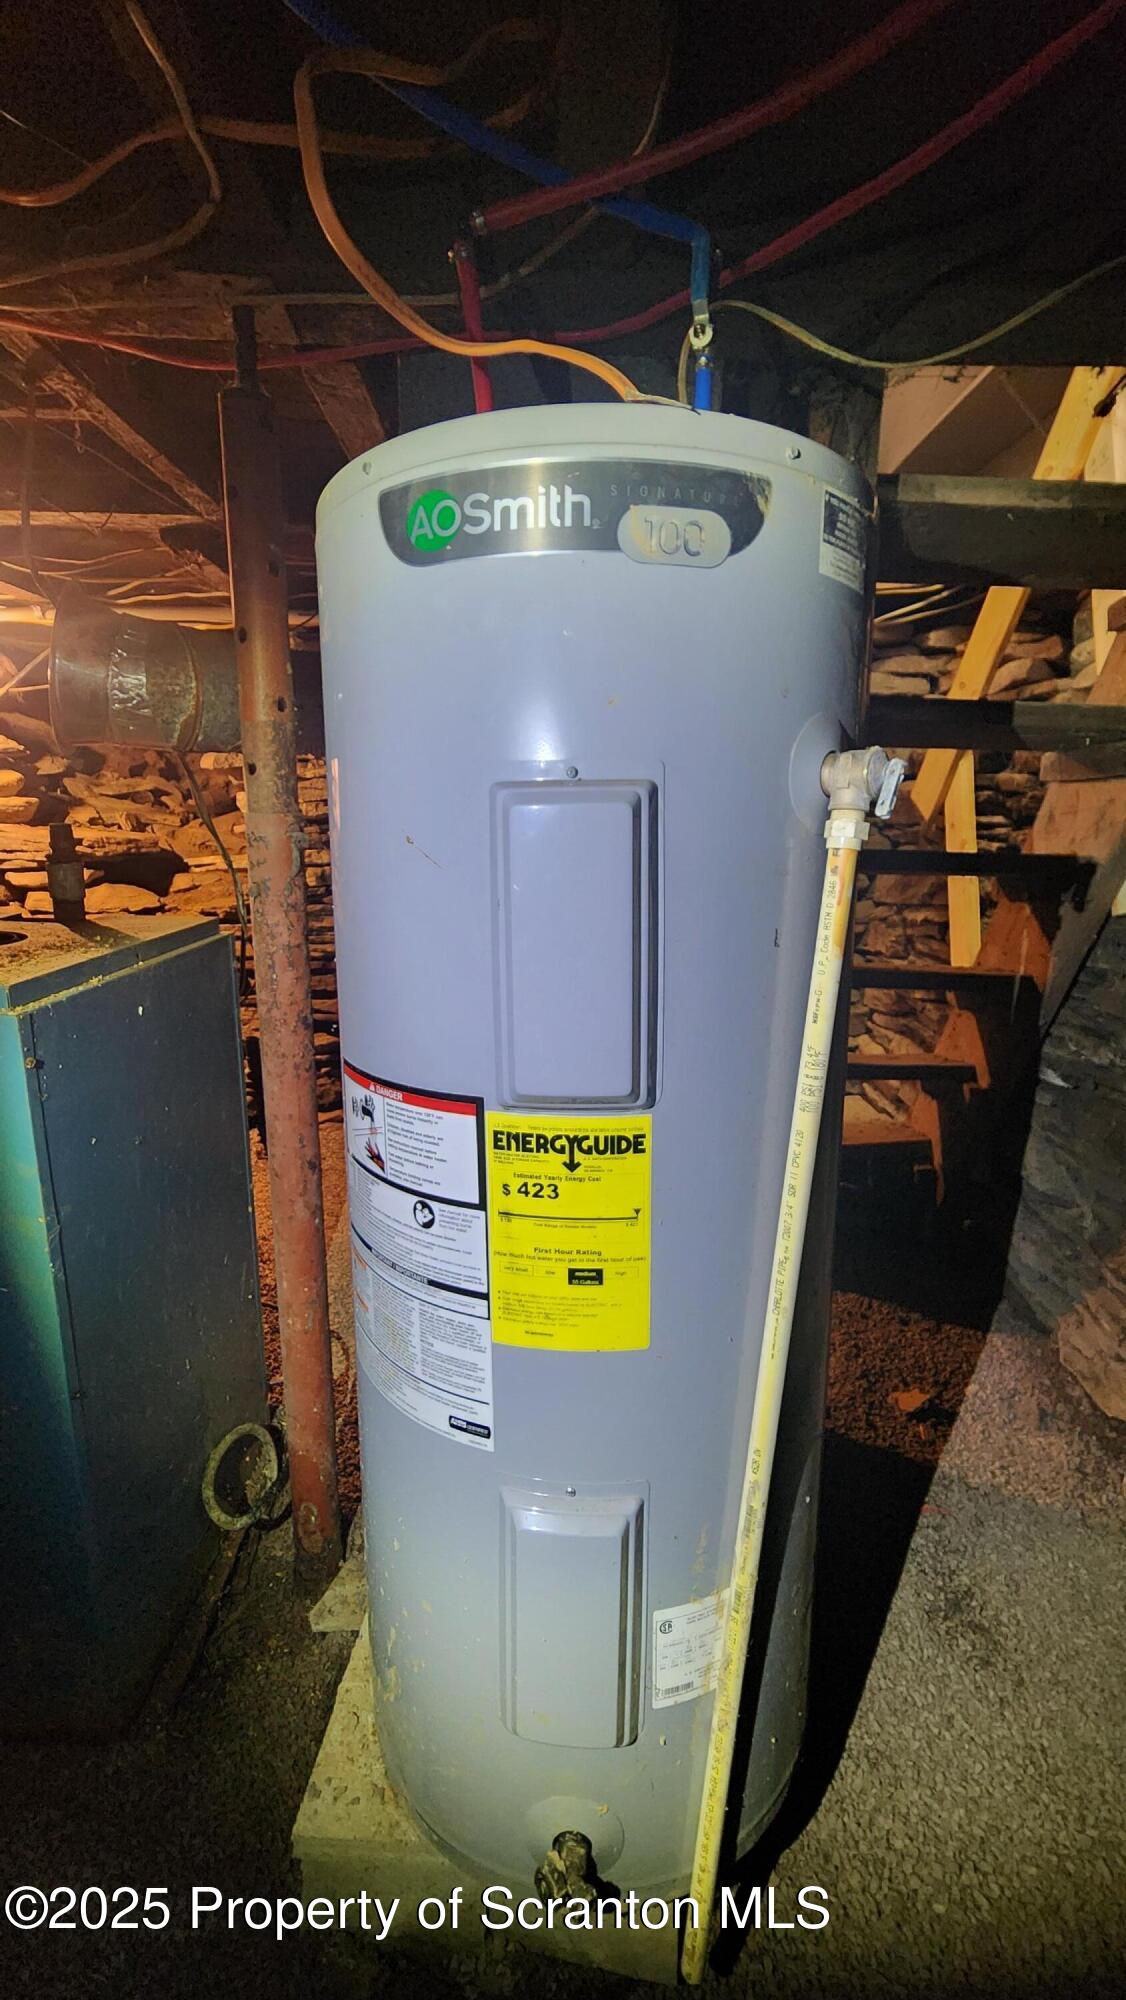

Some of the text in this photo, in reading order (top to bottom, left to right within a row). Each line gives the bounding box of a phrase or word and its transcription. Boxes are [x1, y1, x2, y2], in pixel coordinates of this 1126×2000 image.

[644, 515, 705, 557] 100
[375, 1083, 403, 1102] DANGER
[493, 1130, 647, 1156] ENERGYGUIDE
[502, 1181, 560, 1200] $ 423
[533, 1246, 552, 1254] First
[575, 1249, 602, 1257] Rating
